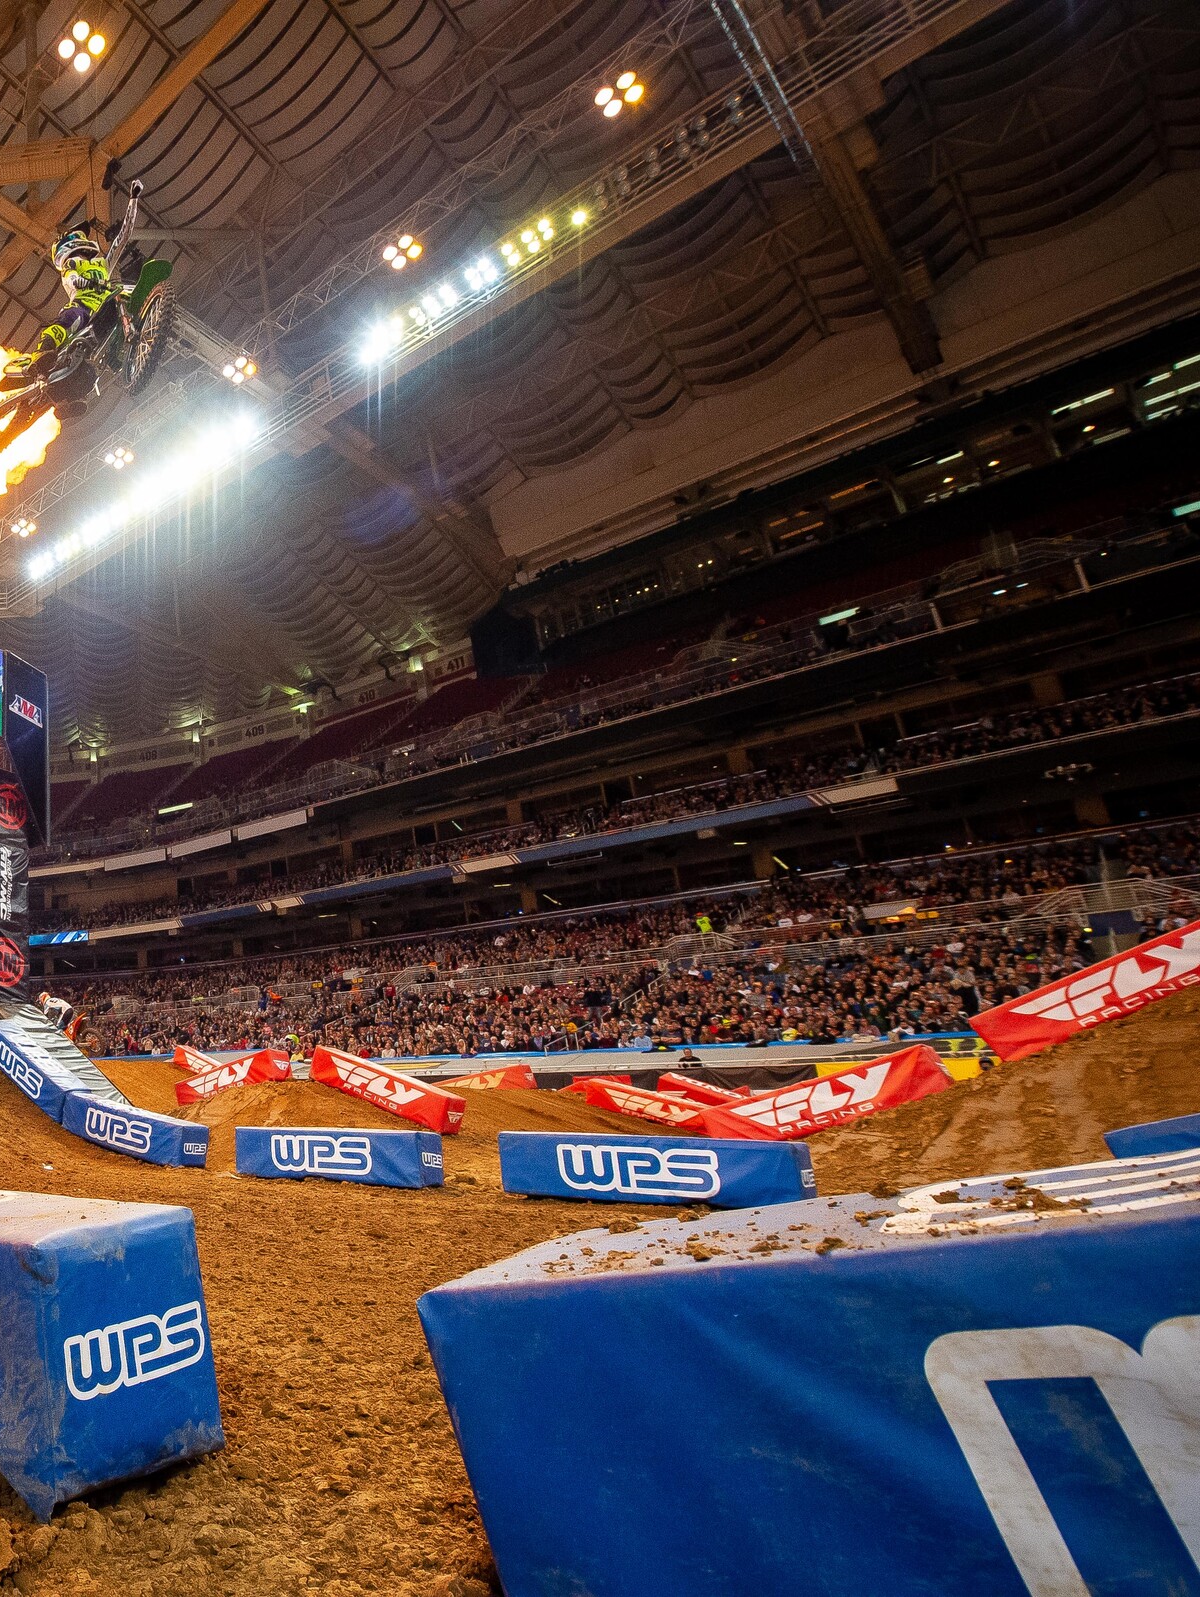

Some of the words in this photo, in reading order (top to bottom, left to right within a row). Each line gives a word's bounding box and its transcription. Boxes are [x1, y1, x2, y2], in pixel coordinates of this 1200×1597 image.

[447, 656, 466, 670] 411
[9, 694, 43, 728] AMA
[1009, 929, 1200, 1021] FLY
[1078, 973, 1200, 1027] RACING
[187, 1057, 254, 1094] FLY
[331, 1056, 426, 1105] FLY
[443, 1071, 506, 1089] FLY
[729, 1062, 892, 1126] FLY
[343, 1083, 398, 1110] RACING
[604, 1087, 700, 1122] FLY
[85, 1107, 152, 1155] WPS
[778, 1102, 875, 1133] RACING
[183, 1142, 206, 1155] WPS
[271, 1135, 373, 1176] WPS
[421, 1151, 443, 1168] WPS
[556, 1144, 721, 1199] WPS
[64, 1300, 206, 1401] WPS
